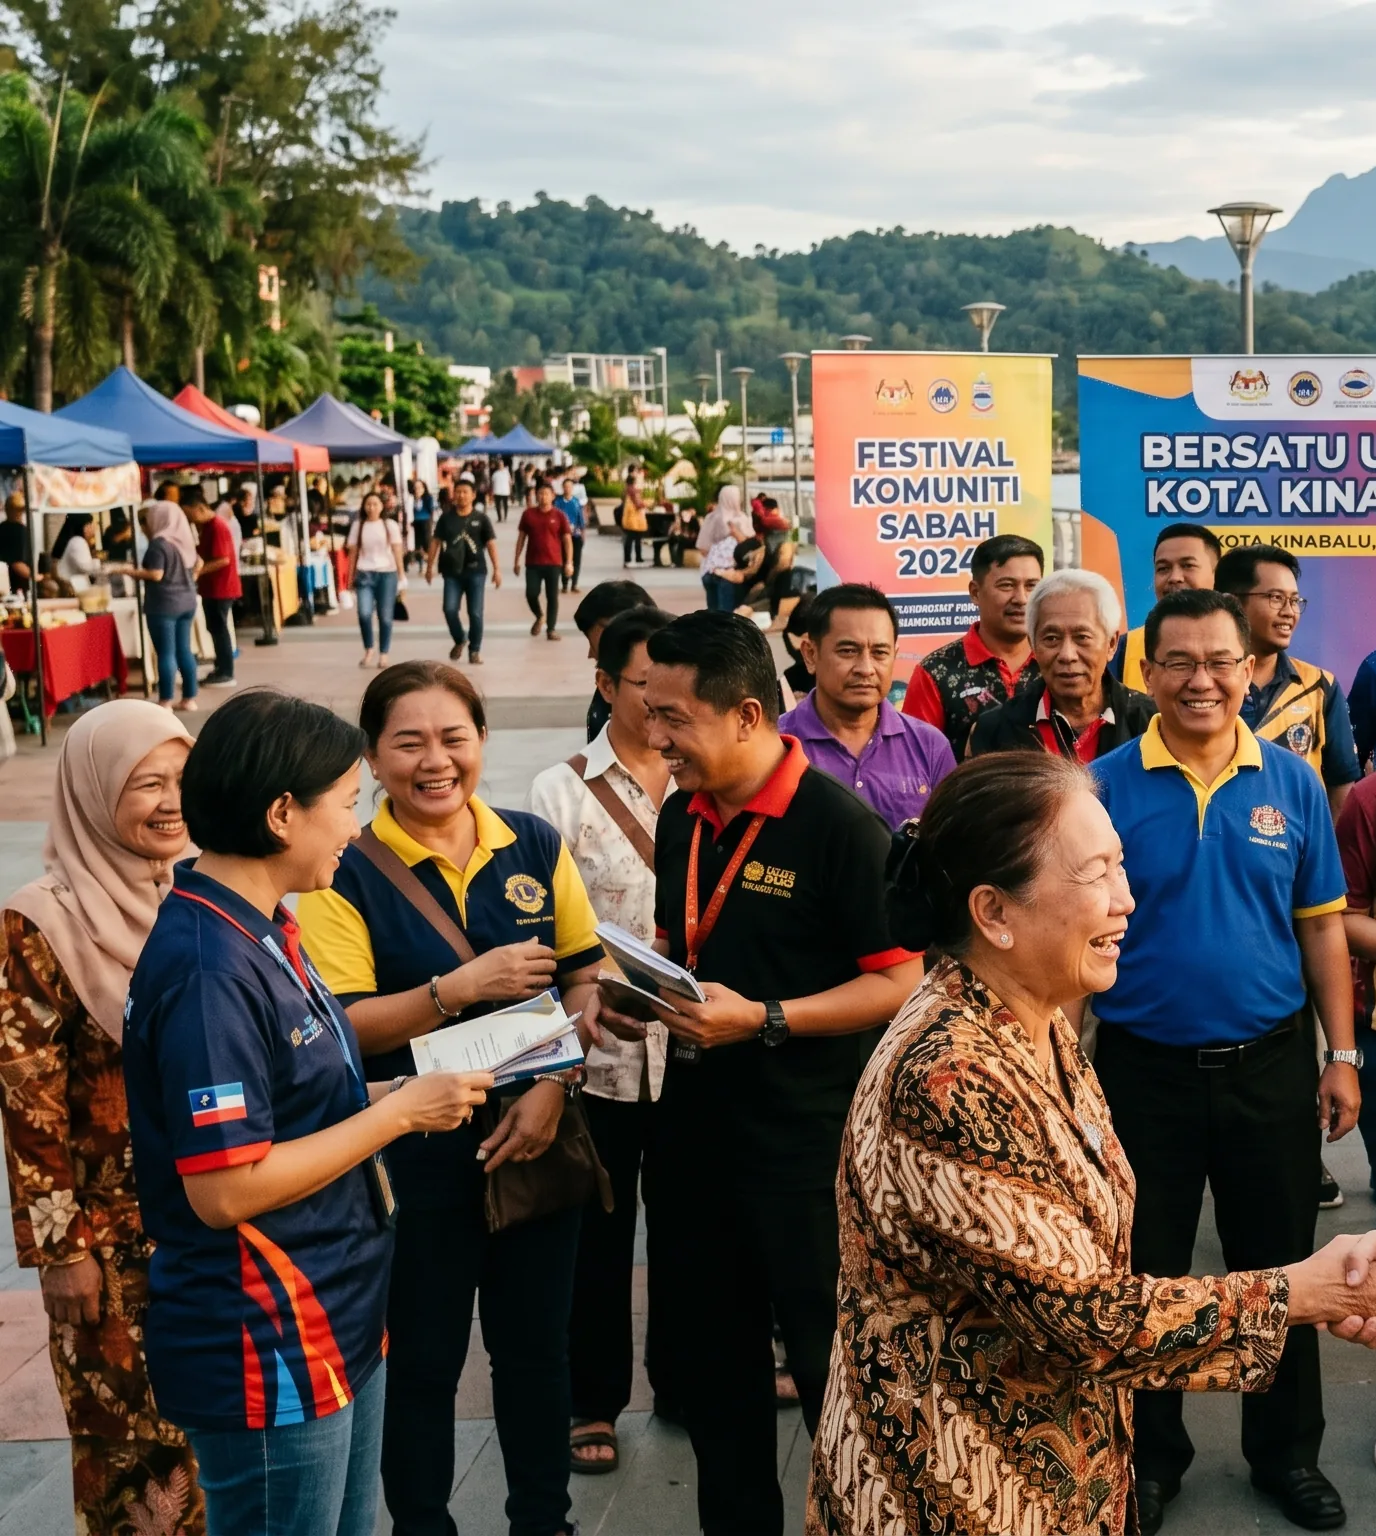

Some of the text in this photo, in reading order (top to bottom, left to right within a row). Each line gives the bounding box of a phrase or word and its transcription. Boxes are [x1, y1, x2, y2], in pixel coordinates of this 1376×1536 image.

[857, 441, 1014, 469] FESTIVAL
[1143, 435, 1350, 470] BERSATU
[853, 476, 1019, 505] KOMUNITI
[1147, 479, 1268, 514] KOTA
[879, 512, 995, 540] SABAH
[1270, 535, 1376, 550] KINABALU,
